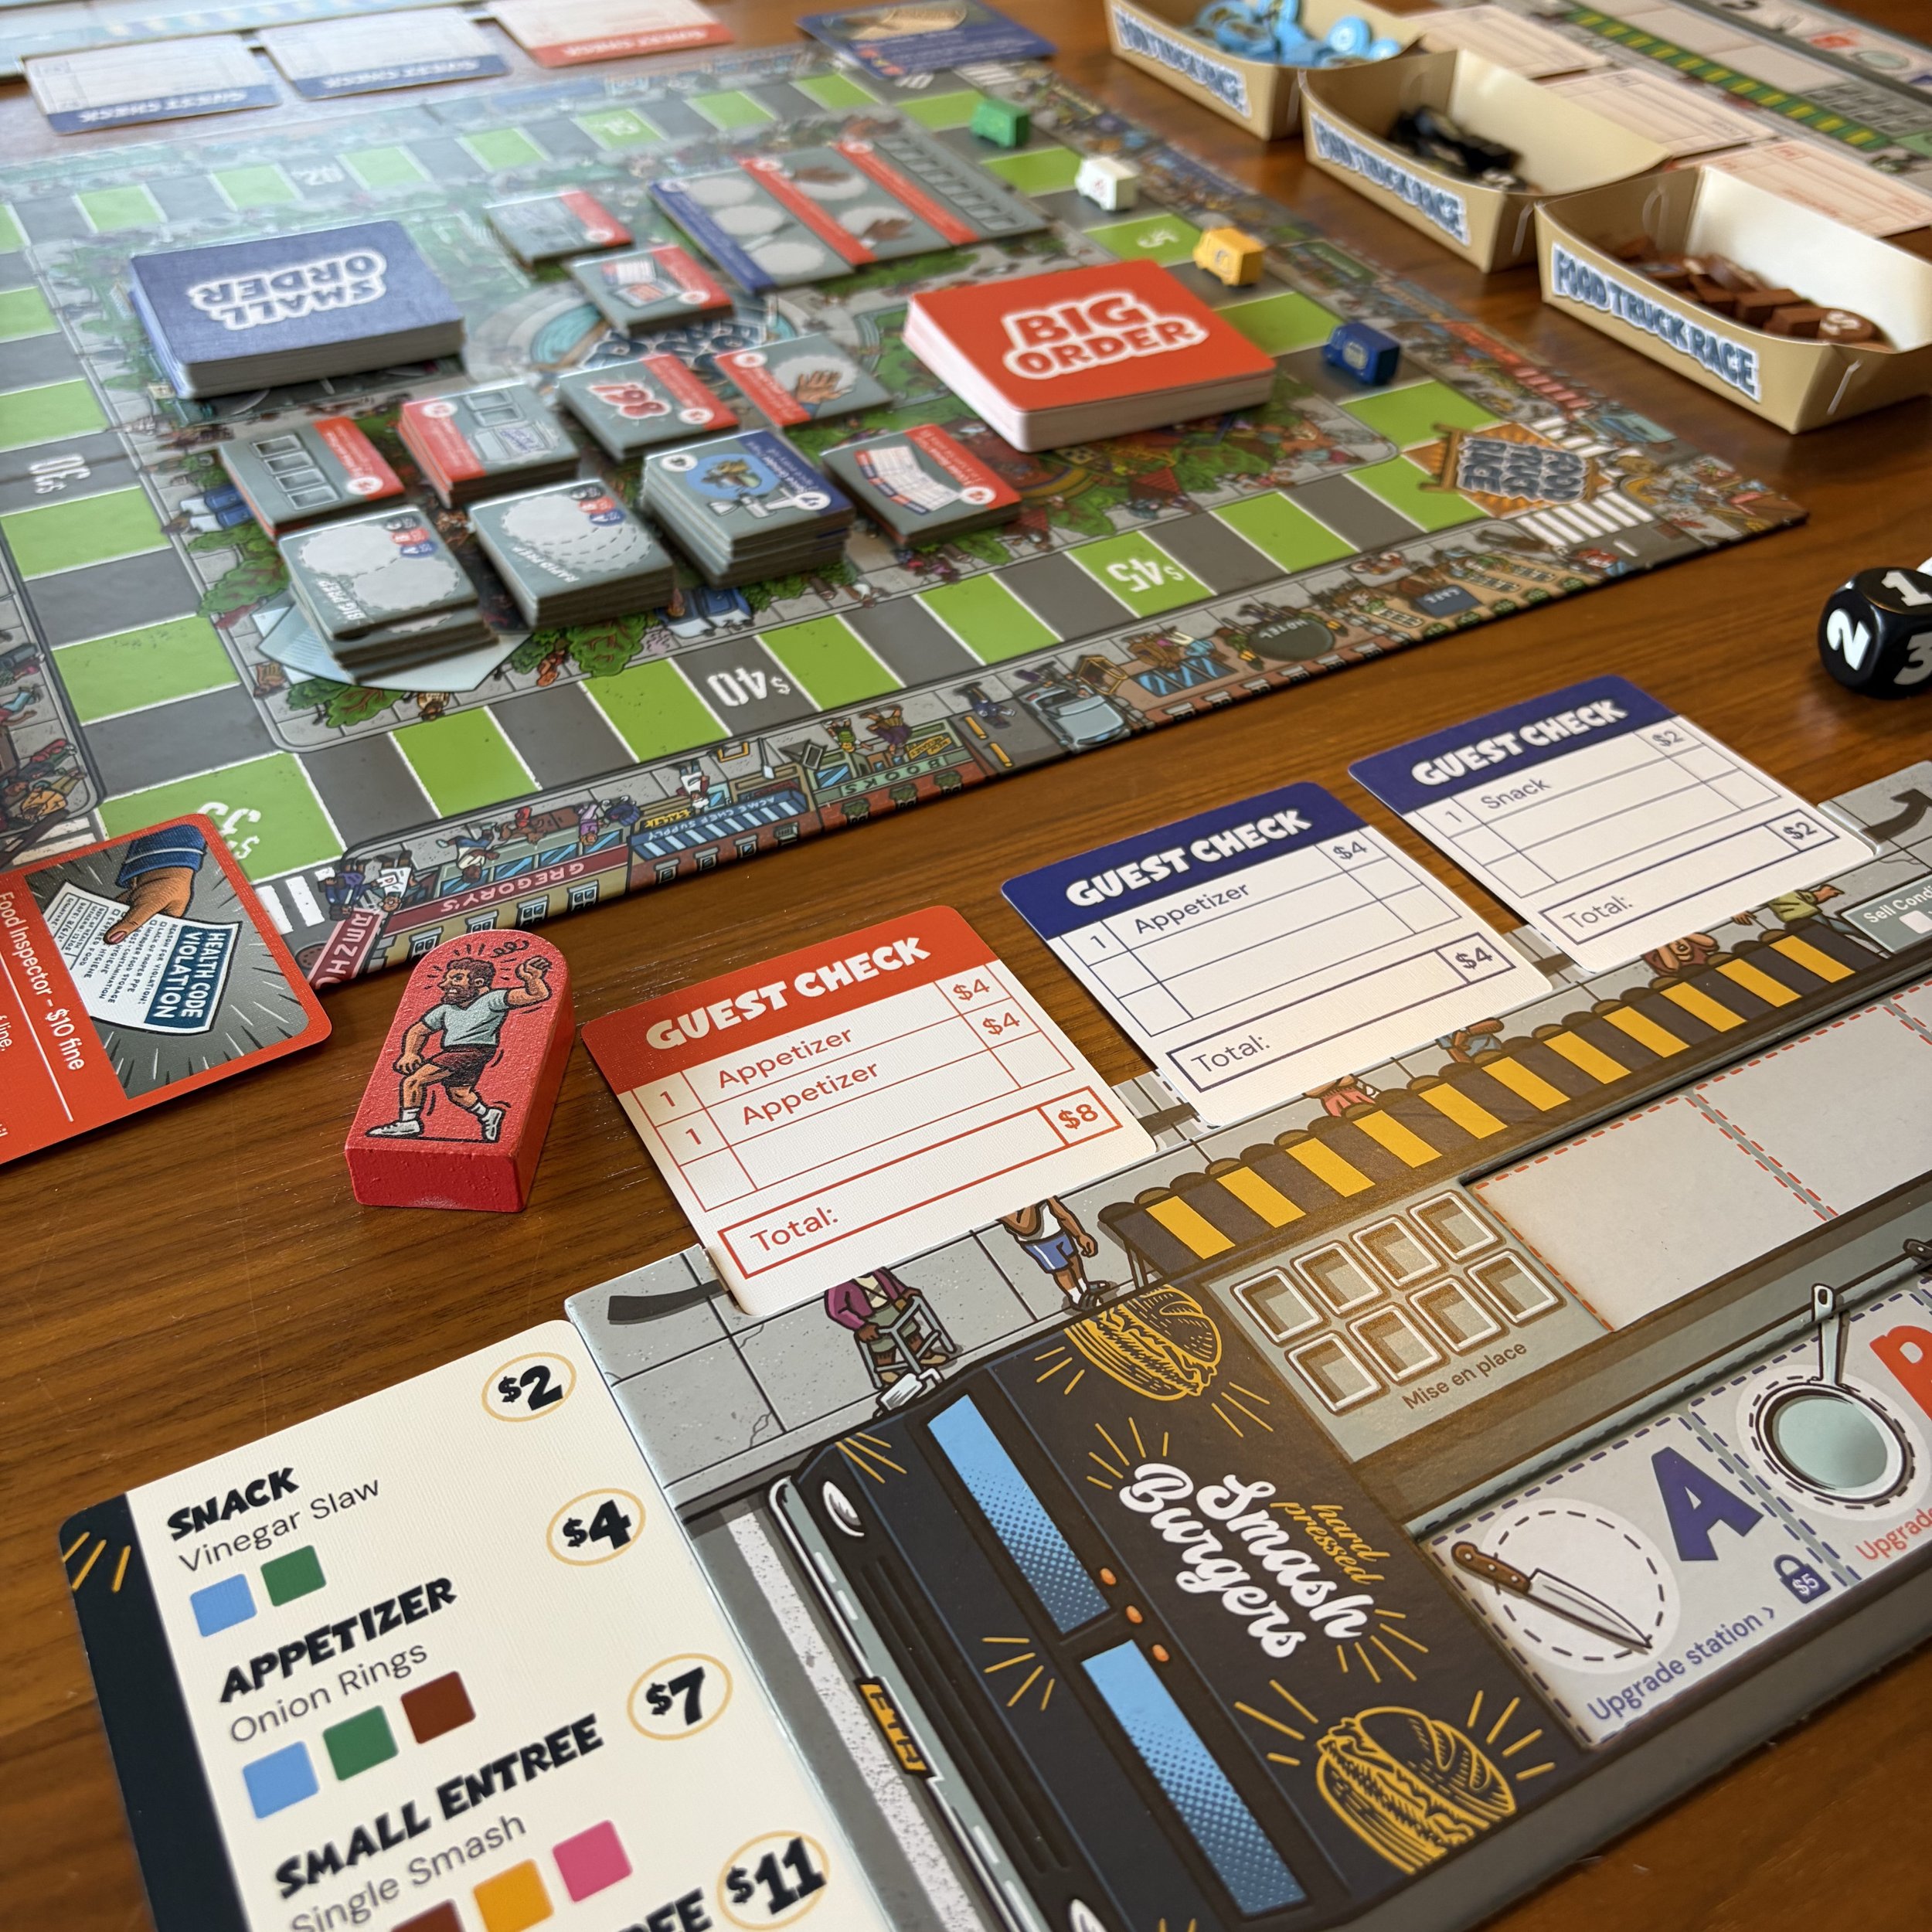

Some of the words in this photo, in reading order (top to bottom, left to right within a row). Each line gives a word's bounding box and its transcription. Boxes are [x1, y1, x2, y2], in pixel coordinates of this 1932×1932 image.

[201, 253, 377, 307] ORDER
[221, 277, 376, 328] SMALL
[1014, 296, 1150, 347] BIG
[1017, 321, 1198, 375] ORDER
[1556, 249, 1608, 305] FOOD
[1608, 280, 1689, 348] TRUCK
[1689, 326, 1756, 395] RACE
[1107, 558, 1186, 594] $45
[1882, 570, 1932, 606] 1
[1259, 620, 1308, 641] HOTEL
[1827, 608, 1871, 671] 2
[1893, 631, 1932, 685] 3
[706, 667, 791, 707] $40
[1410, 730, 1530, 787] GUEST
[1520, 699, 1630, 750] CHECK
[739, 795, 774, 814] ACME
[844, 758, 940, 794] BOOKS
[1444, 809, 1464, 825] 1
[1481, 774, 1553, 810] Snack
[1651, 729, 1686, 750] $2
[645, 819, 696, 842] SUPPLY
[702, 807, 736, 825] CHEF
[439, 862, 586, 914] GREGORY'S
[1066, 847, 1191, 908] GUEST
[1189, 808, 1313, 863] CHECK
[1563, 893, 1634, 929] Total:
[1783, 821, 1818, 843] $2
[0, 891, 28, 928] Food
[1090, 934, 1107, 951] 1
[1135, 881, 1250, 936] Appetizer
[1332, 838, 1369, 862] $4
[1863, 903, 1897, 923] Sell
[9, 925, 54, 996] Inspector
[79, 947, 95, 967] FOOD
[93, 917, 115, 946] EXPIRED
[100, 944, 124, 975] HYGIENE
[193, 932, 226, 979] HEALTH
[83, 947, 107, 979] HYGIENE
[107, 972, 131, 1005] STORAGE
[127, 978, 138, 994] PPE
[152, 931, 203, 1019] VIOLATION
[45, 1008, 76, 1038] $10
[180, 982, 212, 1019] CODE
[645, 980, 791, 1051] GUEST
[793, 936, 932, 999] CHECK
[1191, 1033, 1272, 1076] Total:
[1455, 945, 1495, 971] $4
[58, 1036, 85, 1071] fine
[660, 1090, 677, 1110] 1
[719, 1026, 853, 1089] Appetizer
[953, 977, 992, 1003] $4
[685, 1128, 702, 1148] 1
[743, 1060, 880, 1127] Appetizer
[982, 1011, 1022, 1038] $4
[750, 1202, 840, 1254] Total:
[1058, 1102, 1100, 1131] $8
[496, 1363, 563, 1412] $2
[1402, 1383, 1451, 1411] Mise
[1451, 1367, 1475, 1386] en
[1475, 1341, 1528, 1376] place
[167, 1465, 300, 1542] SNACK
[178, 1512, 302, 1574] Vinegar
[310, 1477, 381, 1521] Slaw
[561, 1498, 632, 1551] $4
[1311, 1503, 1389, 1563] hard
[1651, 1446, 1764, 1561] A
[1119, 1463, 1307, 1658] Burgers
[1196, 1474, 1374, 1639] Smash
[1270, 1501, 1384, 1586] pressed
[1791, 1573, 1820, 1596] $5
[219, 1577, 458, 1703] APPETIZER
[1587, 1655, 1686, 1722] Upgrade
[1686, 1610, 1762, 1664] station
[229, 1682, 331, 1745] Onion
[337, 1640, 429, 1698] Rings
[645, 1665, 706, 1727] $7
[869, 1689, 922, 1763] FTR
[274, 1801, 434, 1901] SMALL
[437, 1713, 607, 1823] ENTREE
[291, 1869, 403, 1932] Single
[406, 1813, 529, 1889] Smash
[724, 1835, 828, 1917] $11
